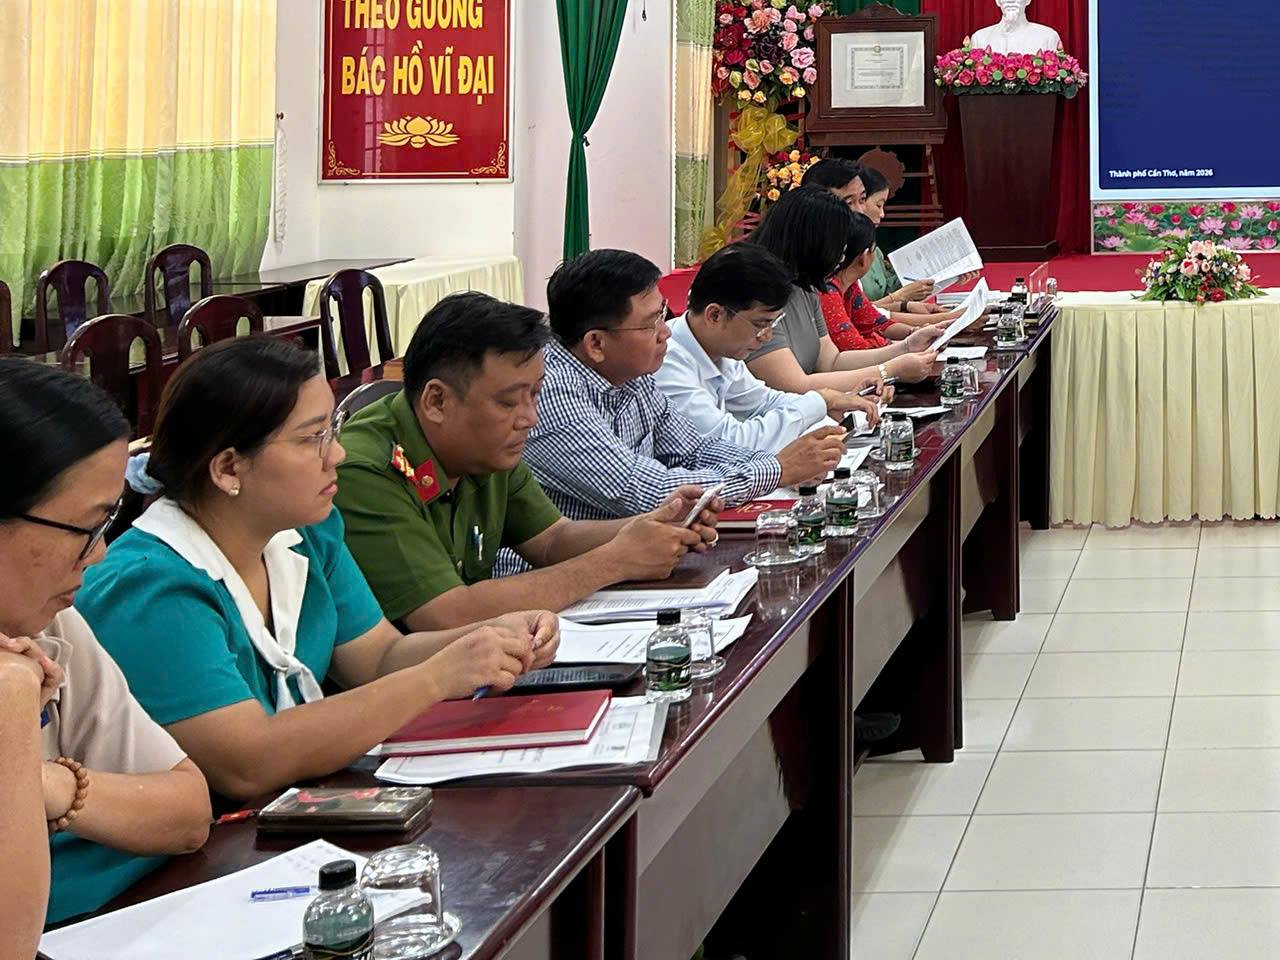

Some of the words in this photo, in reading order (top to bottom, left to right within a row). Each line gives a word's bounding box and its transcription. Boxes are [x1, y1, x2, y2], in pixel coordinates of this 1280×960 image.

[342, 47, 385, 95] BÁC
[393, 40, 423, 95] HỒ
[429, 46, 453, 94] VĨ
[458, 56, 494, 104] ĐẠI
